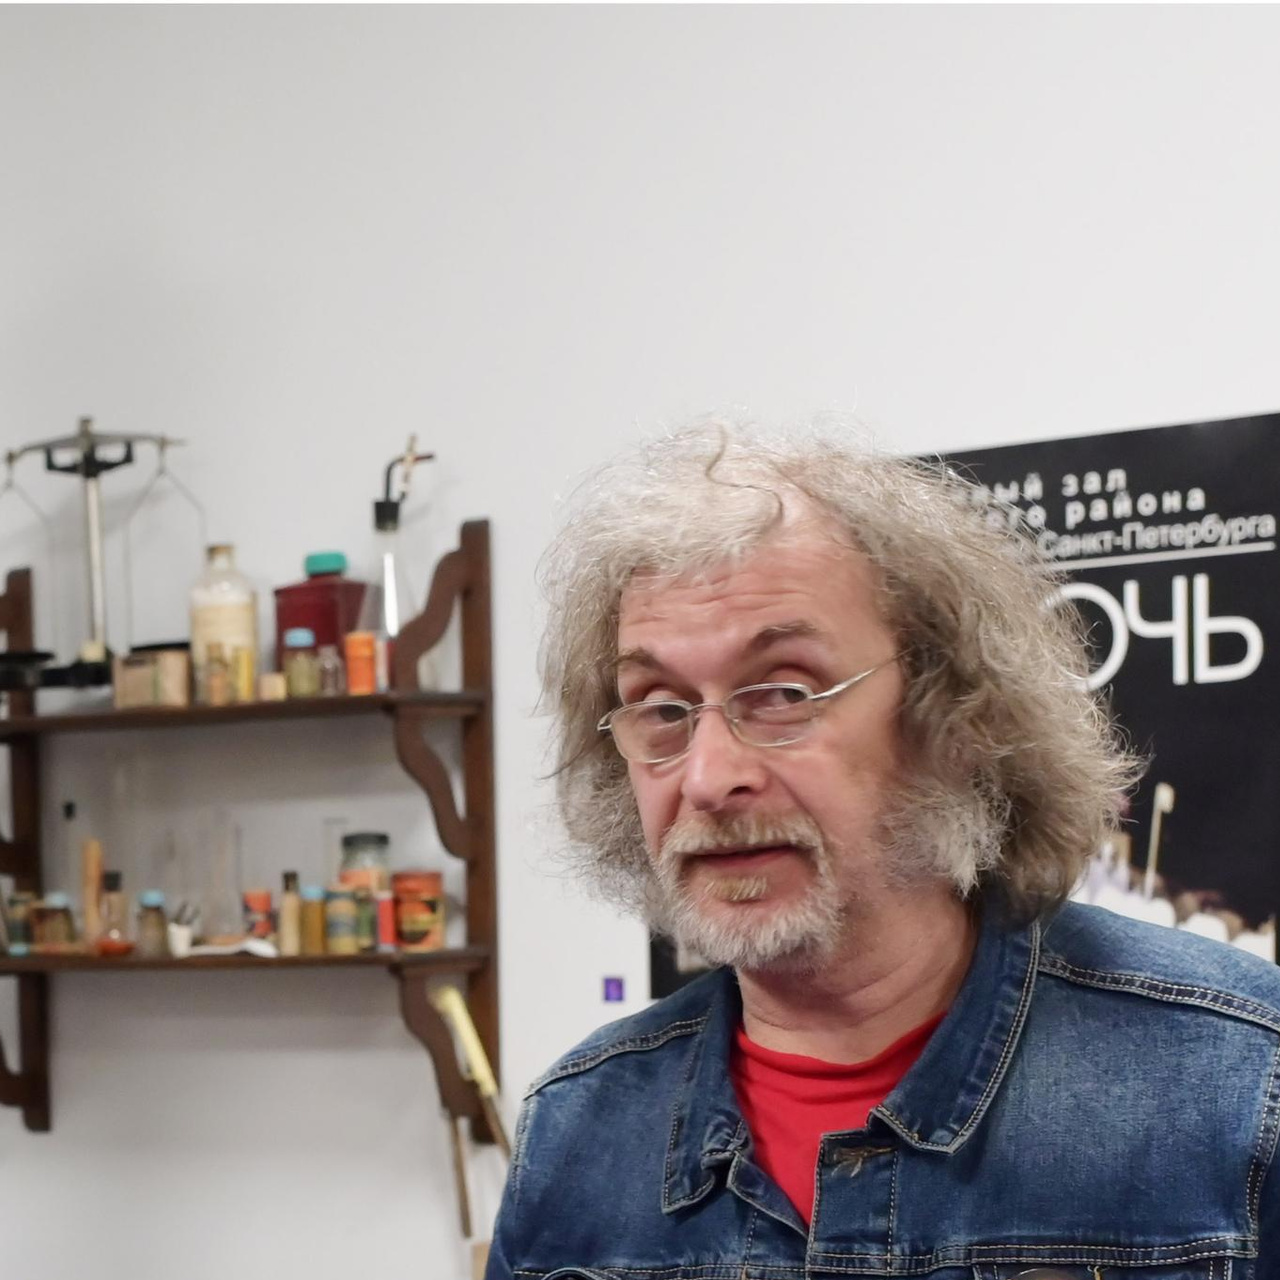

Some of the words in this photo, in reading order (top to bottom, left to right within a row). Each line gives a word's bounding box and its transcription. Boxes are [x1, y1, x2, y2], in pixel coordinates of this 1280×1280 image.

[1061, 468, 1127, 497] зал
[1065, 487, 1206, 530] района
[1037, 513, 1276, 558] Санкт-Петербурга
